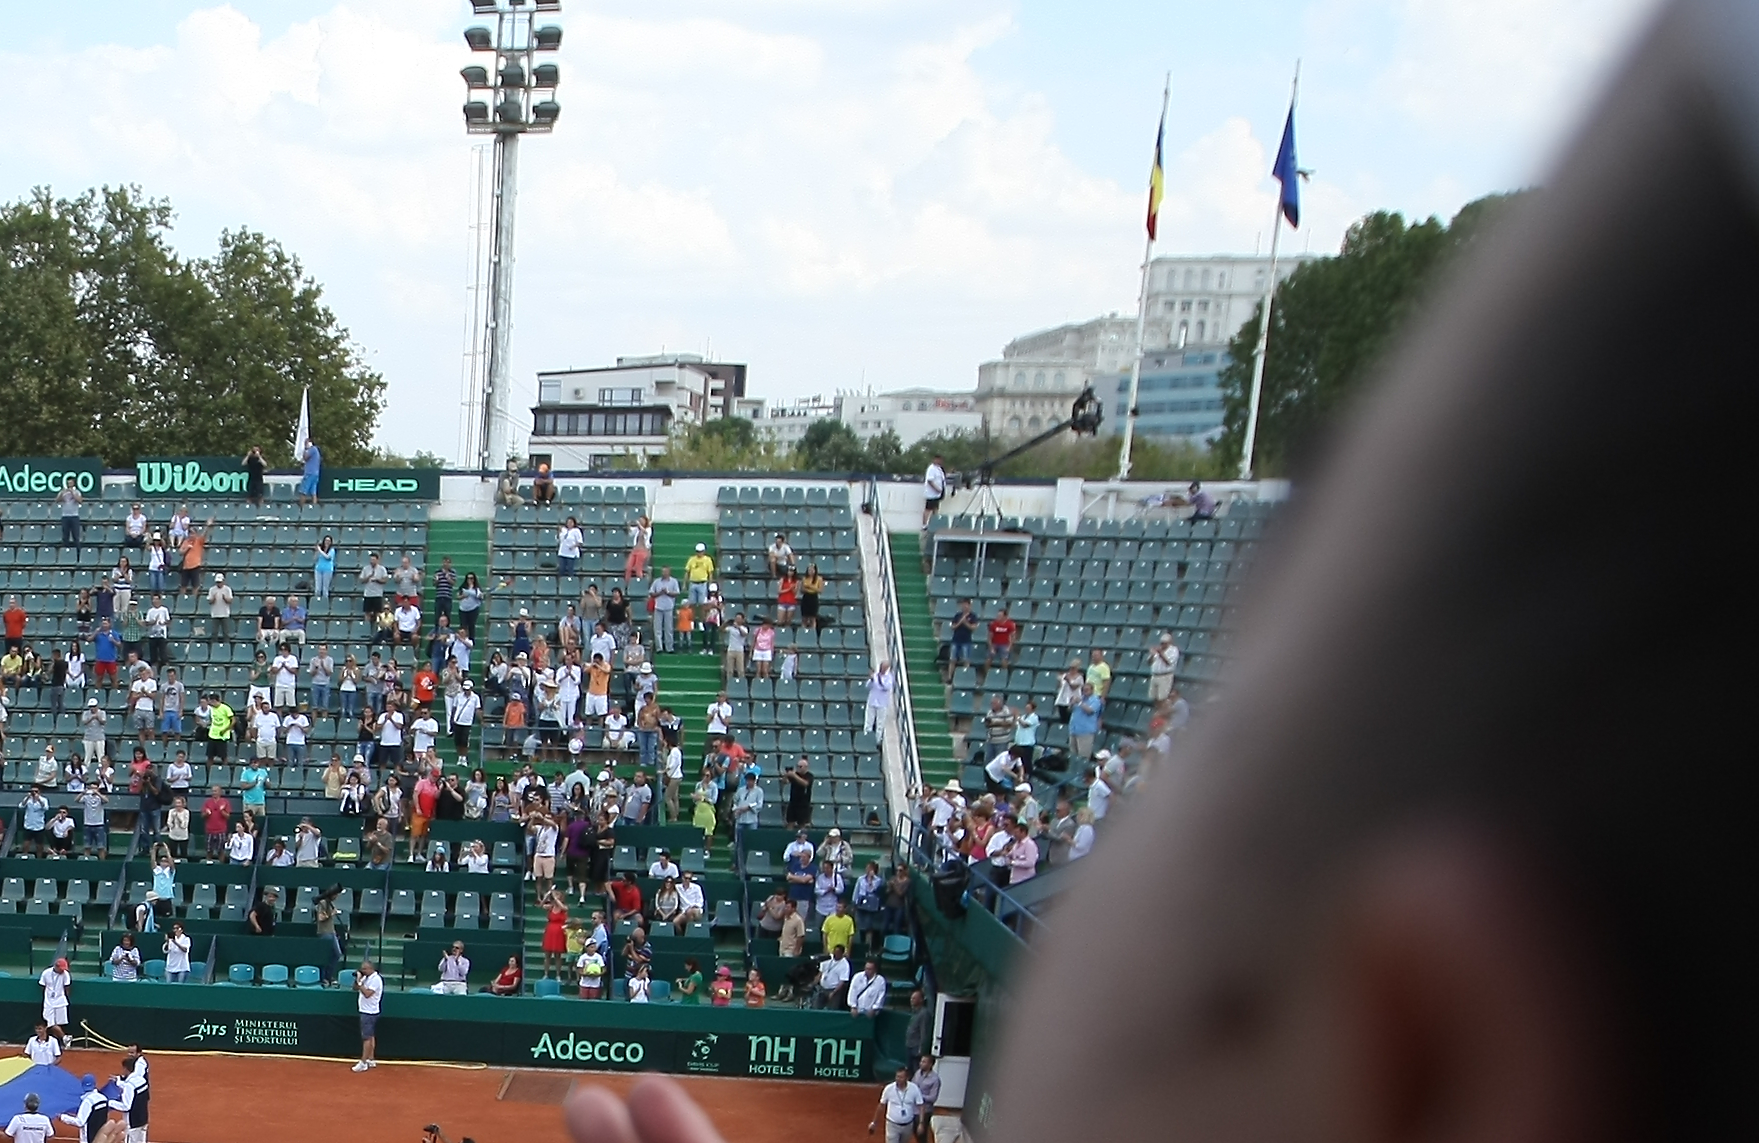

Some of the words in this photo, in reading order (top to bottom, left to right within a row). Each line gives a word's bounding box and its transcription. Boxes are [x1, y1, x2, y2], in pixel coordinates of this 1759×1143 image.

[333, 477, 419, 492] HEAD
[198, 1024, 227, 1036] MTS
[234, 1019, 298, 1030] MINISTERUL
[530, 1031, 645, 1063] Adecco
[748, 1064, 795, 1076] HOTELS
[814, 1067, 860, 1078] HOTELS
